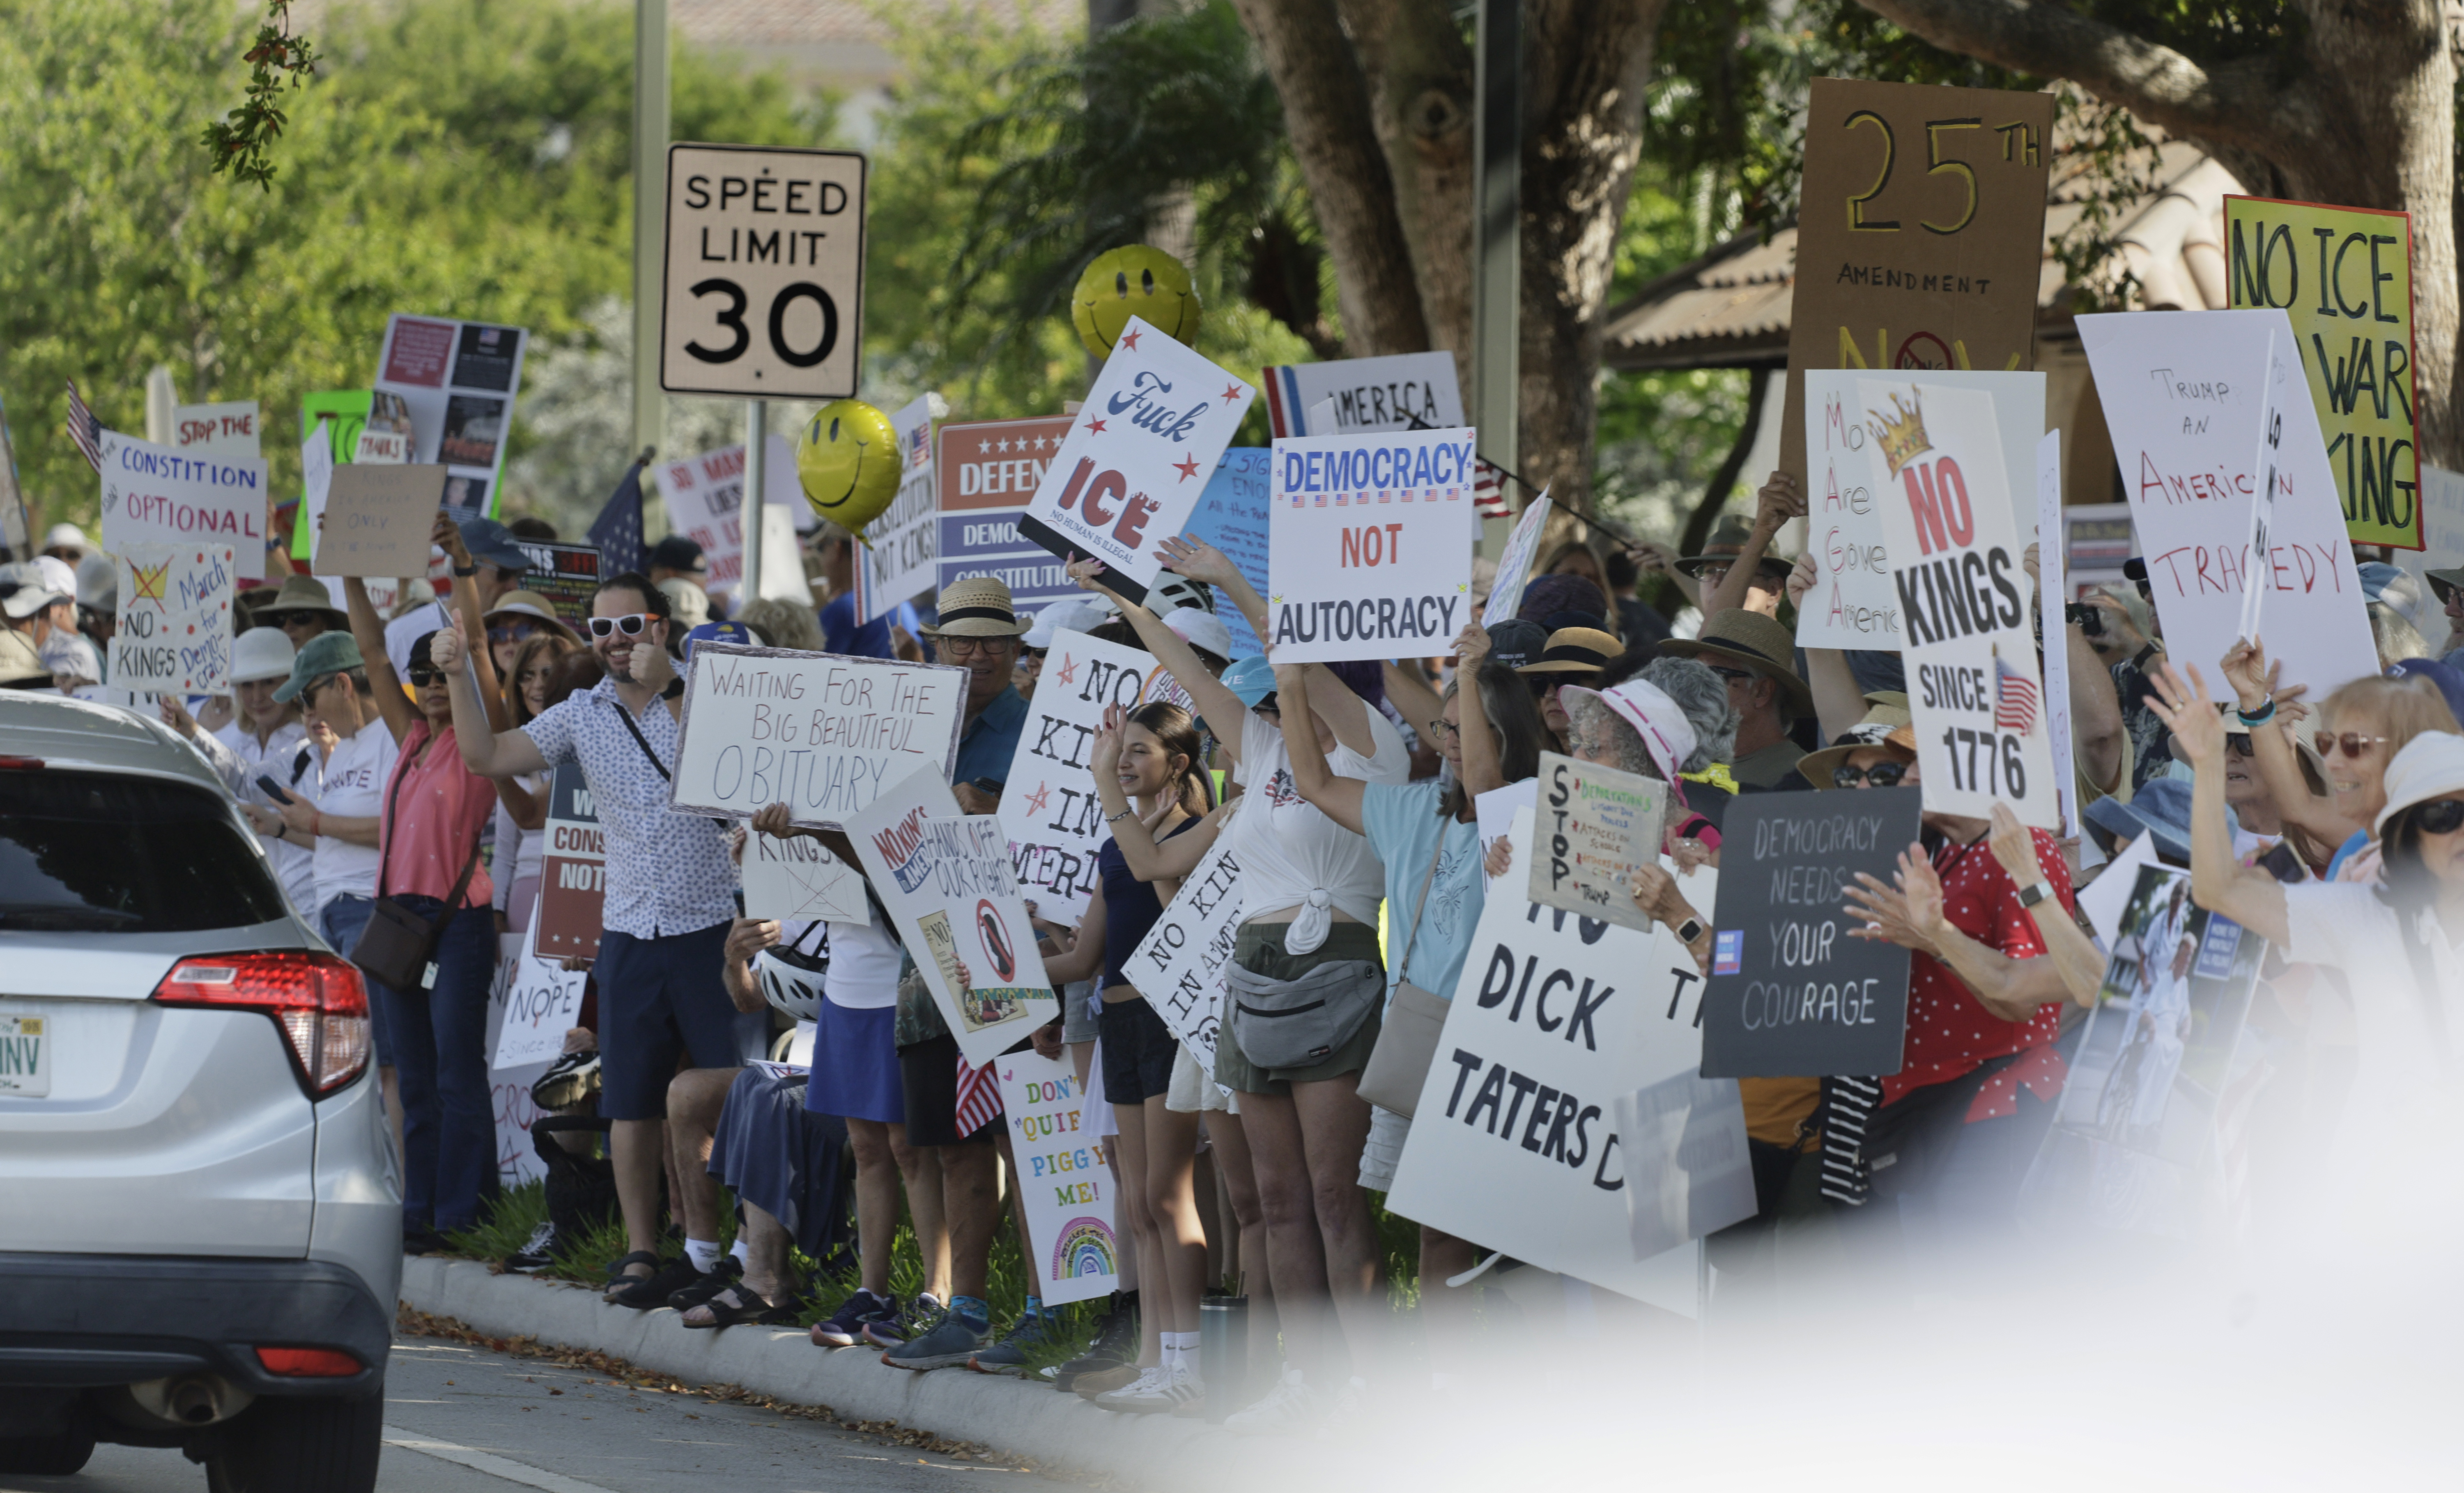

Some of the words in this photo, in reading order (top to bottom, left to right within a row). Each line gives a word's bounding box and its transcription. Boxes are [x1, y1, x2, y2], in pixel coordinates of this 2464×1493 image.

[685, 175, 846, 215] SPEED
[701, 226, 827, 266] LIMIT
[1837, 263, 1991, 294] AMENDMENT
[2233, 219, 2298, 309] NO
[2313, 227, 2399, 323] ICE
[684, 278, 838, 367] 30
[2150, 368, 2230, 405] TRUMP
[2313, 333, 2413, 425] WAR
[179, 419, 216, 446] STOP
[222, 414, 252, 436] THE
[1107, 371, 1209, 442] Fuck
[2183, 415, 2210, 435] AN
[123, 446, 255, 488] CONSTITION
[960, 457, 1055, 496] DEFEN
[1285, 442, 1473, 493] DEMOCRACY
[128, 492, 259, 538] OPTIONAL
[347, 513, 388, 529] ONLY
[1058, 455, 1162, 550] ICE
[1902, 456, 1974, 555] NO
[901, 520, 935, 575] KINGS
[1050, 509, 1063, 522] NO
[1063, 517, 1094, 541] HUMAN
[1093, 534, 1103, 545] IS
[1101, 539, 1134, 565] ILLEGAL
[1342, 523, 1403, 568] NOT
[179, 555, 226, 610] March
[1894, 545, 2023, 647] KINGS
[125, 611, 153, 638] NO
[200, 610, 218, 633] for
[1276, 595, 1458, 644] AUTOCRACY
[118, 646, 175, 677] KINGS
[1079, 659, 1142, 711] NO
[710, 658, 805, 700] WAITING
[824, 668, 872, 709] FOR
[891, 672, 935, 715] THE
[1919, 663, 1990, 712] SINCE
[751, 704, 798, 742] BIG
[809, 709, 924, 753] BEAUTIFUL
[713, 745, 888, 812] OBITUARY
[1942, 727, 2026, 799] 1776
[1049, 787, 1104, 838] IN
[1548, 764, 1570, 892] STOP
[871, 828, 906, 870] NO
[921, 821, 968, 859] HANDS
[968, 820, 997, 858] OFF
[1754, 815, 1883, 860] DEMOCRACY
[559, 863, 605, 892] NOT
[934, 858, 976, 898] OUR
[968, 857, 1015, 897] RIGHTS
[1581, 883, 1610, 906] TRUMP
[1770, 866, 1848, 905] NEEDS
[930, 921, 949, 946] NO
[1148, 922, 1185, 973] NO
[1770, 918, 1836, 968] YOUR
[510, 981, 577, 1024] NOPE
[1168, 969, 1203, 1021] IN
[1478, 943, 1615, 1053] DICK
[1742, 979, 1880, 1030] COURAGE
[1446, 1048, 1601, 1169] TATERS
[1031, 1144, 1106, 1177] PIGGY
[1055, 1181, 1100, 1207] ME!
